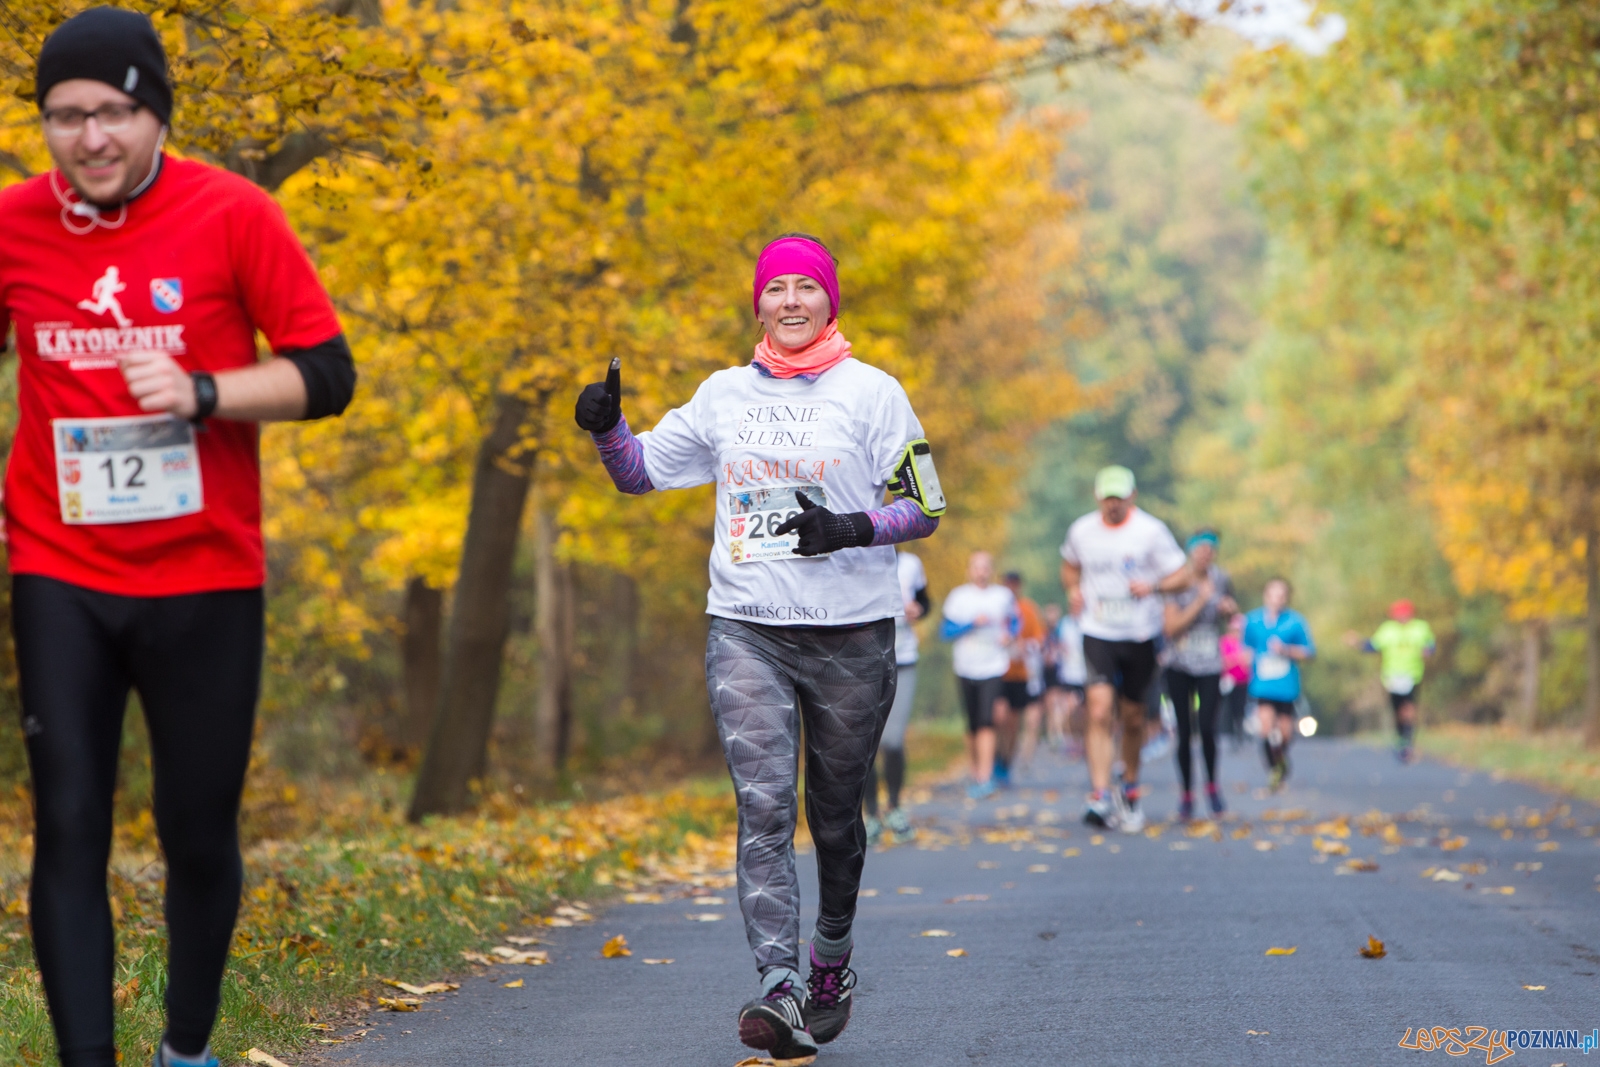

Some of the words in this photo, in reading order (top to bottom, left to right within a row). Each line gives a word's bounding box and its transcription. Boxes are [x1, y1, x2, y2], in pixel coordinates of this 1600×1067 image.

[744, 405, 821, 423] SUKNIE
[734, 426, 814, 447] ŚLUBNE
[99, 455, 146, 489] 12
[732, 602, 828, 620] MIEŚCISKO
